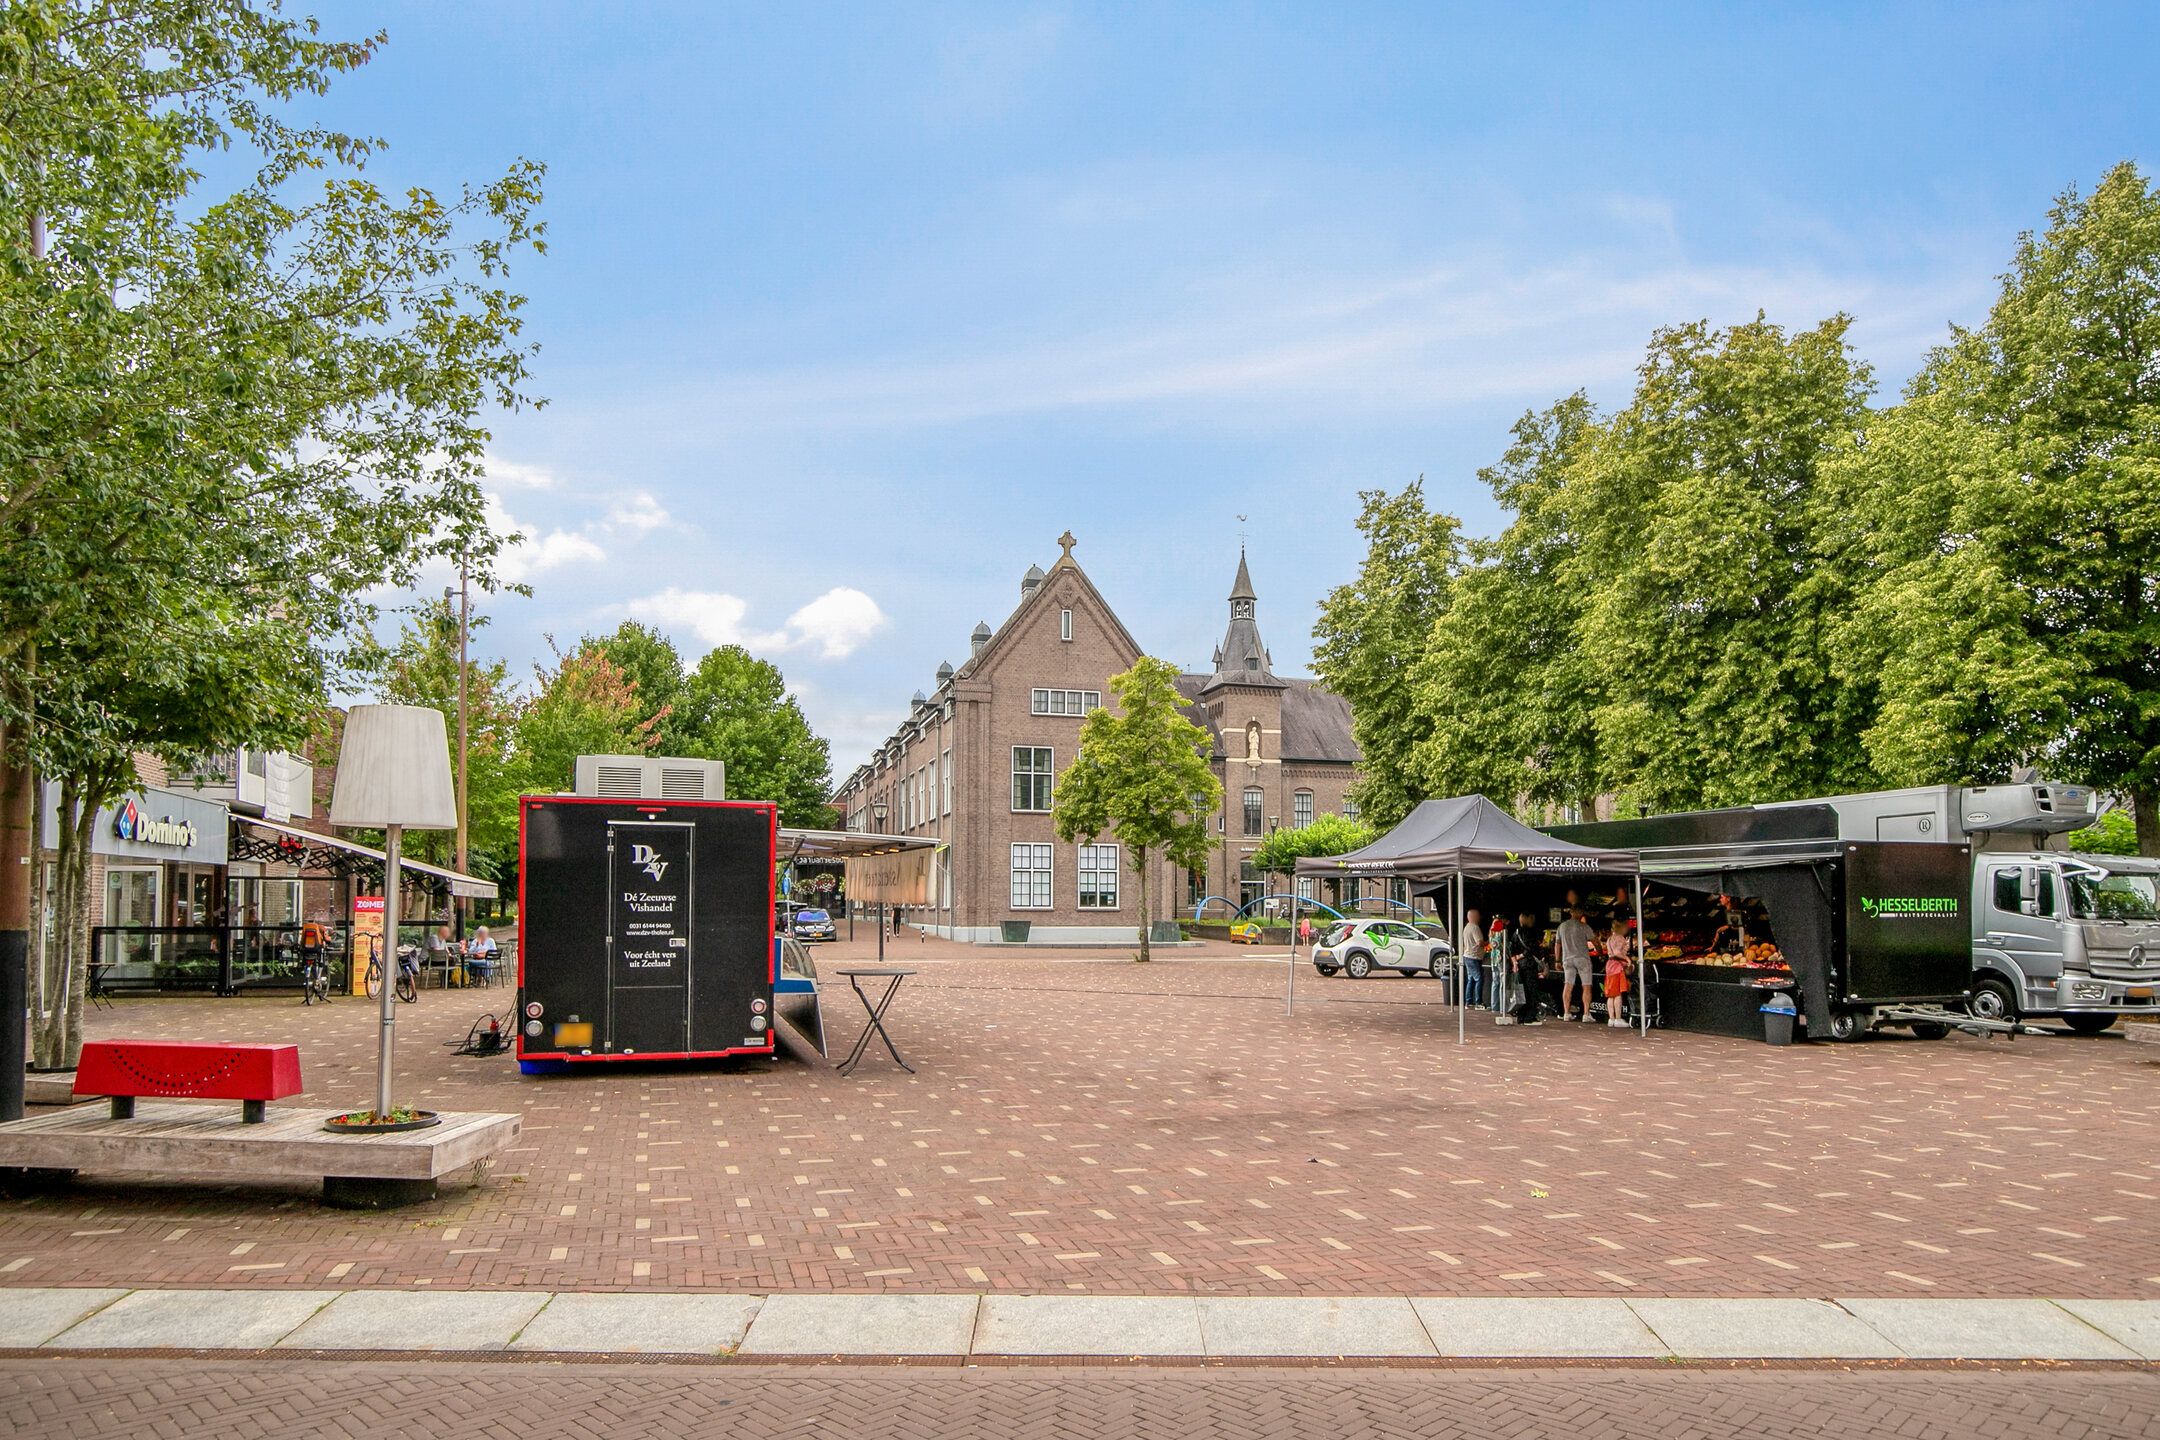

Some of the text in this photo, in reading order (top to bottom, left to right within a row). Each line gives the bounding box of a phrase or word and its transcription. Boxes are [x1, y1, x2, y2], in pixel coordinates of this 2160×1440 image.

[137, 811, 197, 847] Domino's
[1526, 856, 1599, 868] HESSELBERTH
[624, 893, 677, 902] Dé Zeeuwse
[630, 903, 673, 912] Vishandel
[1879, 898, 1958, 912] HESSELBERTH
[624, 951, 643, 959] Voor
[644, 950, 661, 959] écht
[629, 959, 671, 968] uit Zeeland
